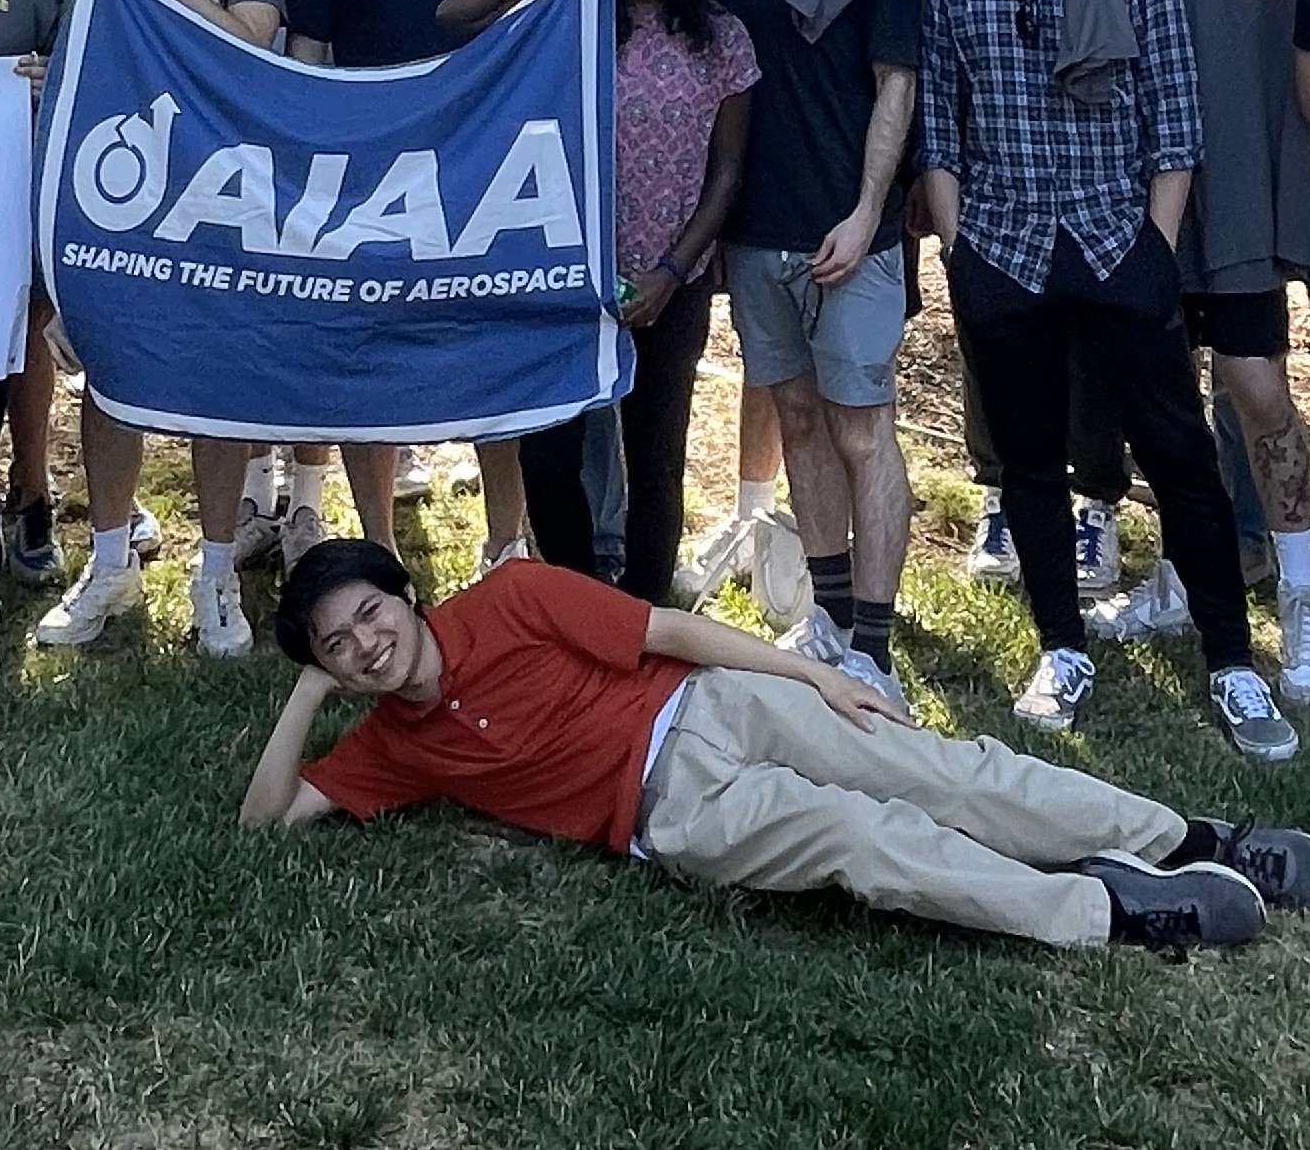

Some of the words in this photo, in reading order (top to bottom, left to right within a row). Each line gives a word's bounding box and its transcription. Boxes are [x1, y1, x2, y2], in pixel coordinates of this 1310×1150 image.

[153, 119, 584, 261] AIAA
[61, 243, 173, 281] SHAPING
[179, 261, 234, 290] THE
[236, 270, 354, 303] FUTURE
[358, 280, 405, 303] OF
[406, 264, 587, 302] AEROSPACE
